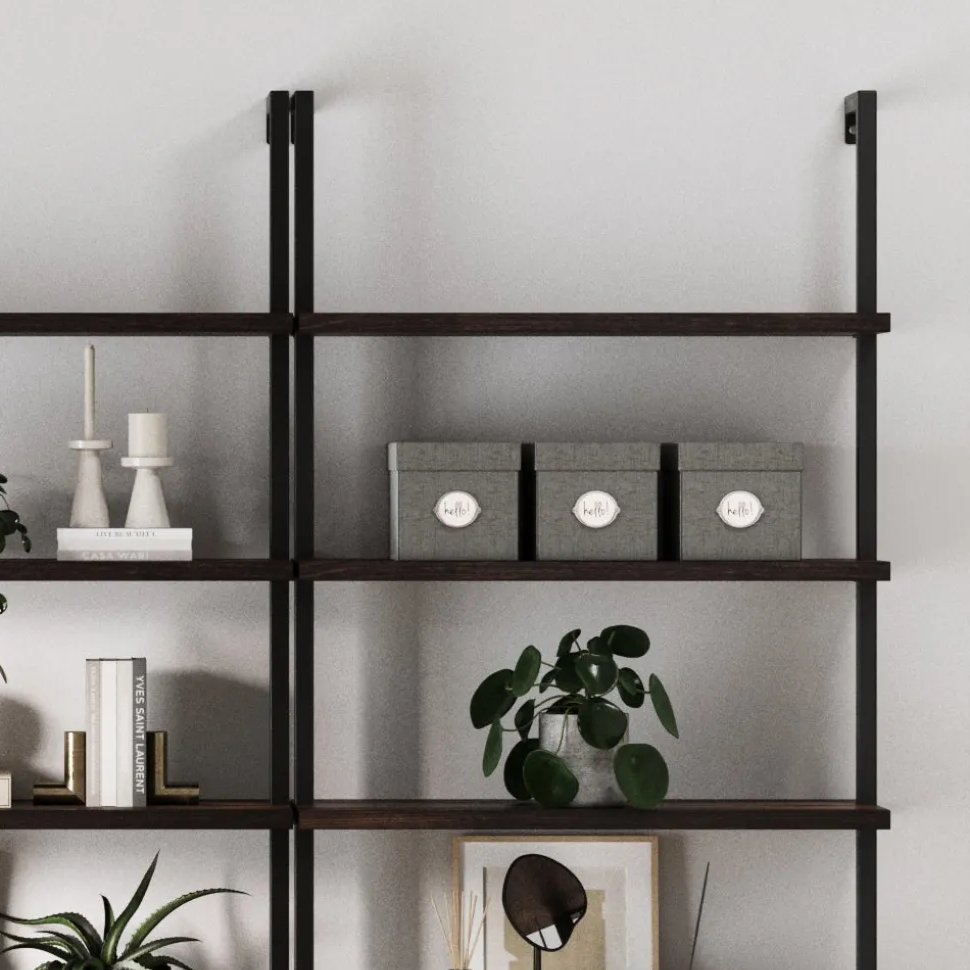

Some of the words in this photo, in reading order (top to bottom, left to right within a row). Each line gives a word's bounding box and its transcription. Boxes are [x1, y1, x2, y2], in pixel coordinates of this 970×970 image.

[443, 500, 471, 517] hello!
[582, 500, 610, 517] hello!
[726, 500, 754, 517] hello!
[135, 675, 145, 704] YVES
[135, 707, 145, 740] SAINT
[135, 743, 145, 795] LAURENT
